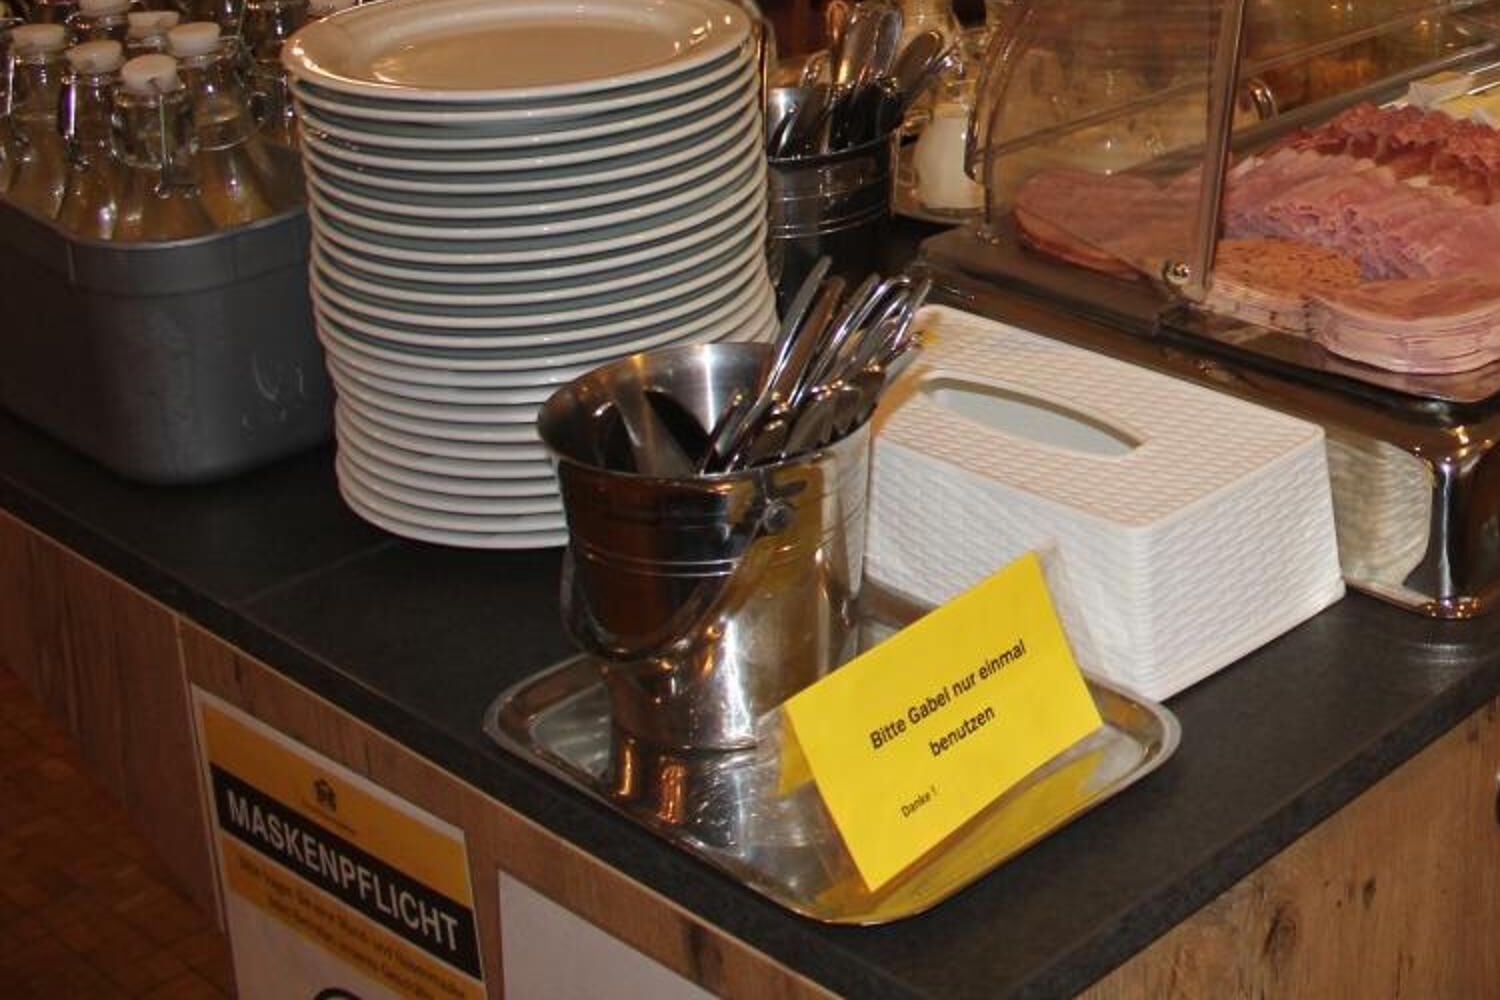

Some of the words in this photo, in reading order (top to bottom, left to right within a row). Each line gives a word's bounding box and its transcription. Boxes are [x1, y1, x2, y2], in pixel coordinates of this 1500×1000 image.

[869, 719, 907, 749] Bitte
[907, 686, 951, 724] Gabel
[951, 671, 977, 697] nur
[978, 638, 1027, 680] einmal
[929, 705, 996, 757] benutzen
[227, 788, 459, 951] MASKENPFLICHT
